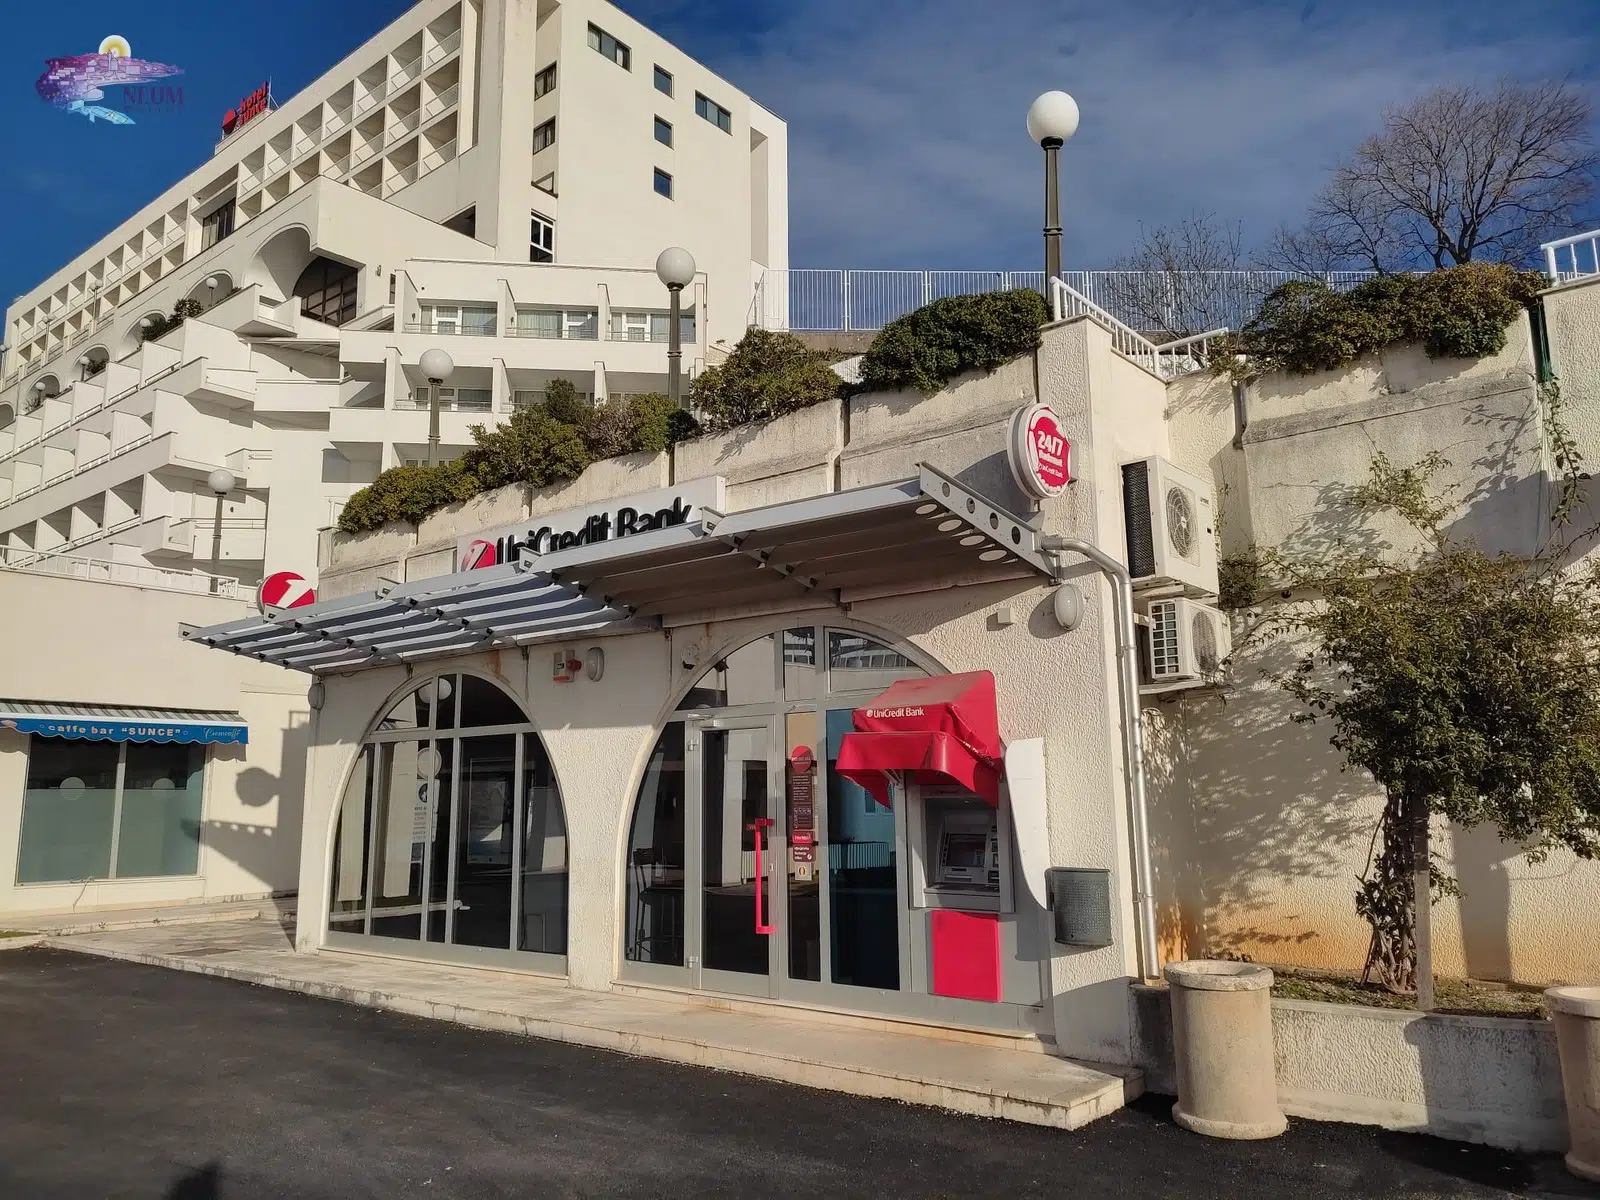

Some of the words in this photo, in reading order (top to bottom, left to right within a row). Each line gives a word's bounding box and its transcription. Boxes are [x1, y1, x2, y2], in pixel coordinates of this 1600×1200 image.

[617, 496, 692, 537] Bank
[874, 708, 904, 718] UniCredit
[905, 707, 925, 717] Bank
[48, 724, 86, 734] caffe
[91, 726, 114, 735] bar
